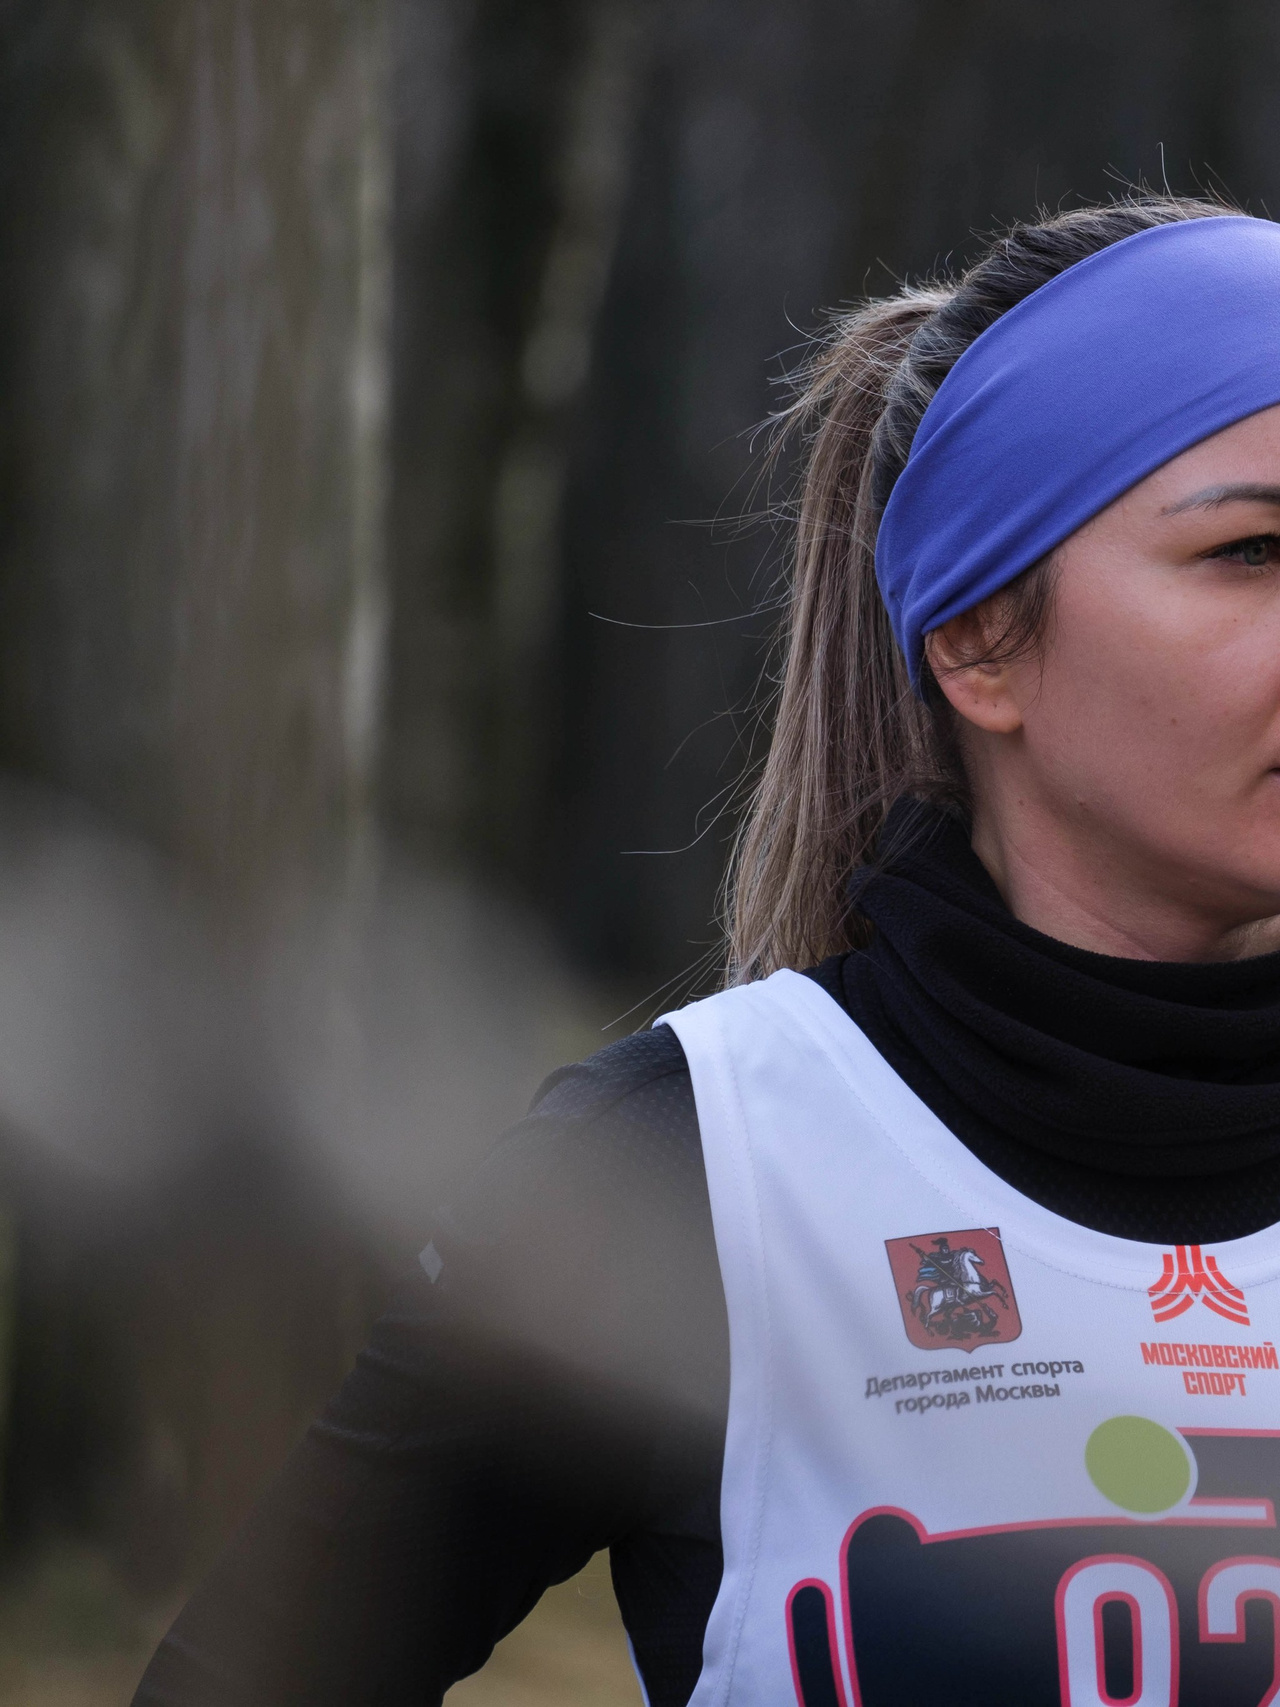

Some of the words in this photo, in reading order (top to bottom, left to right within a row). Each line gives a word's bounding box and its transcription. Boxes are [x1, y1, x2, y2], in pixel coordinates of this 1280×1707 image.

[1140, 1341, 1280, 1370] МОСКОВСКИЙ
[864, 1363, 1005, 1399] Департамент
[1011, 1359, 1085, 1378] спорта
[1182, 1371, 1247, 1397] СПОРТ
[895, 1389, 971, 1415] города
[975, 1383, 1061, 1404] Москвы
